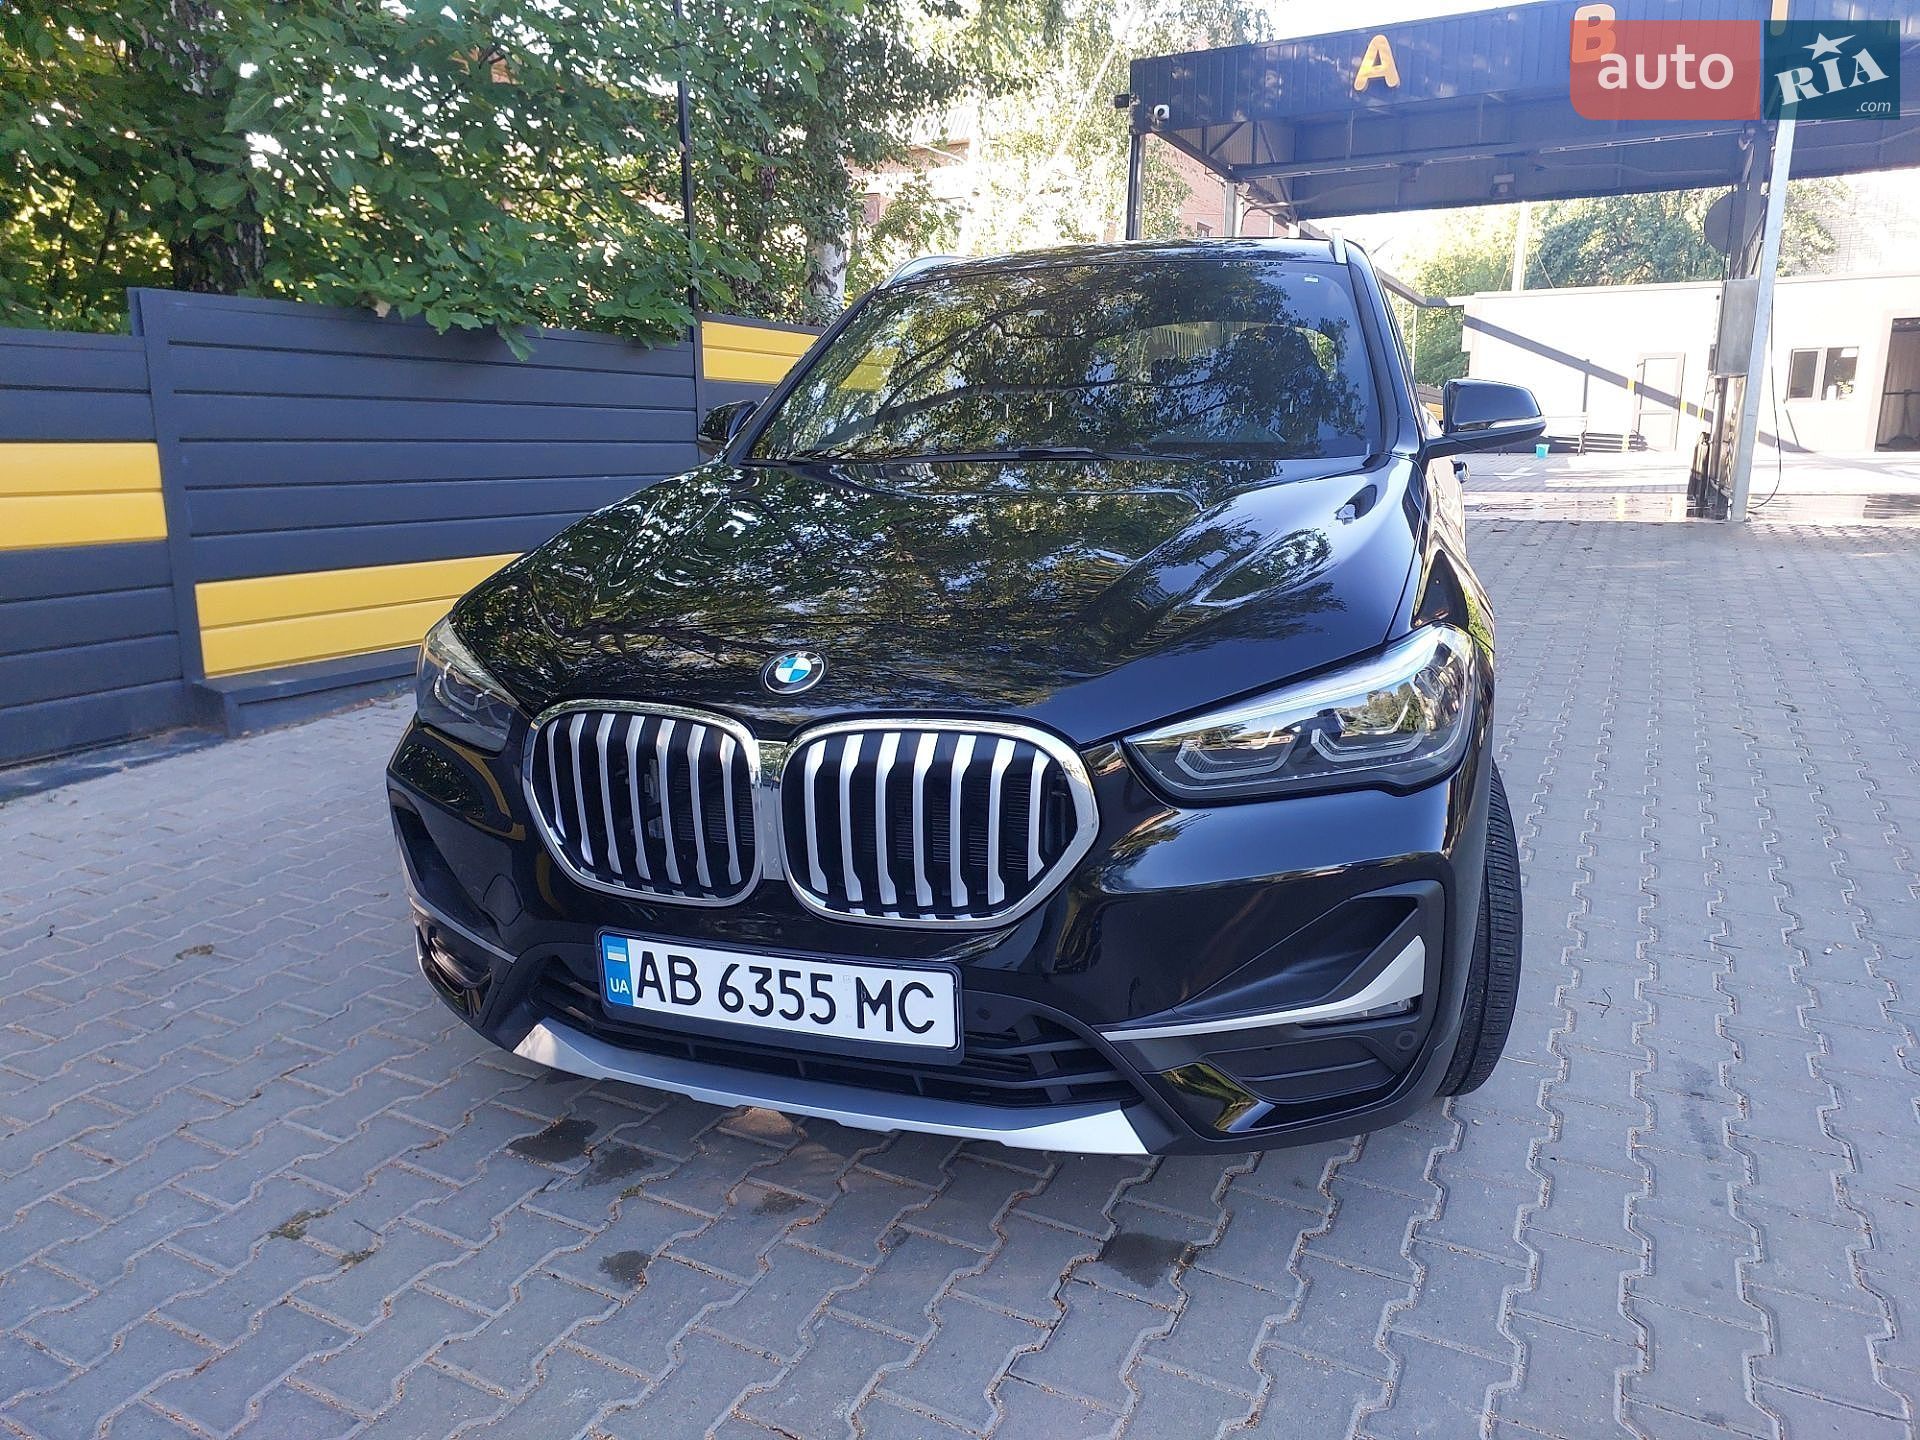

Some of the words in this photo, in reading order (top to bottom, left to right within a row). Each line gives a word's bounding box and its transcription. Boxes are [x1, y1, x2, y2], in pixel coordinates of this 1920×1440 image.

[610, 976, 630, 995] UA
[637, 951, 701, 1005] AB
[718, 963, 836, 1025] 6355
[856, 976, 935, 1034] MC
